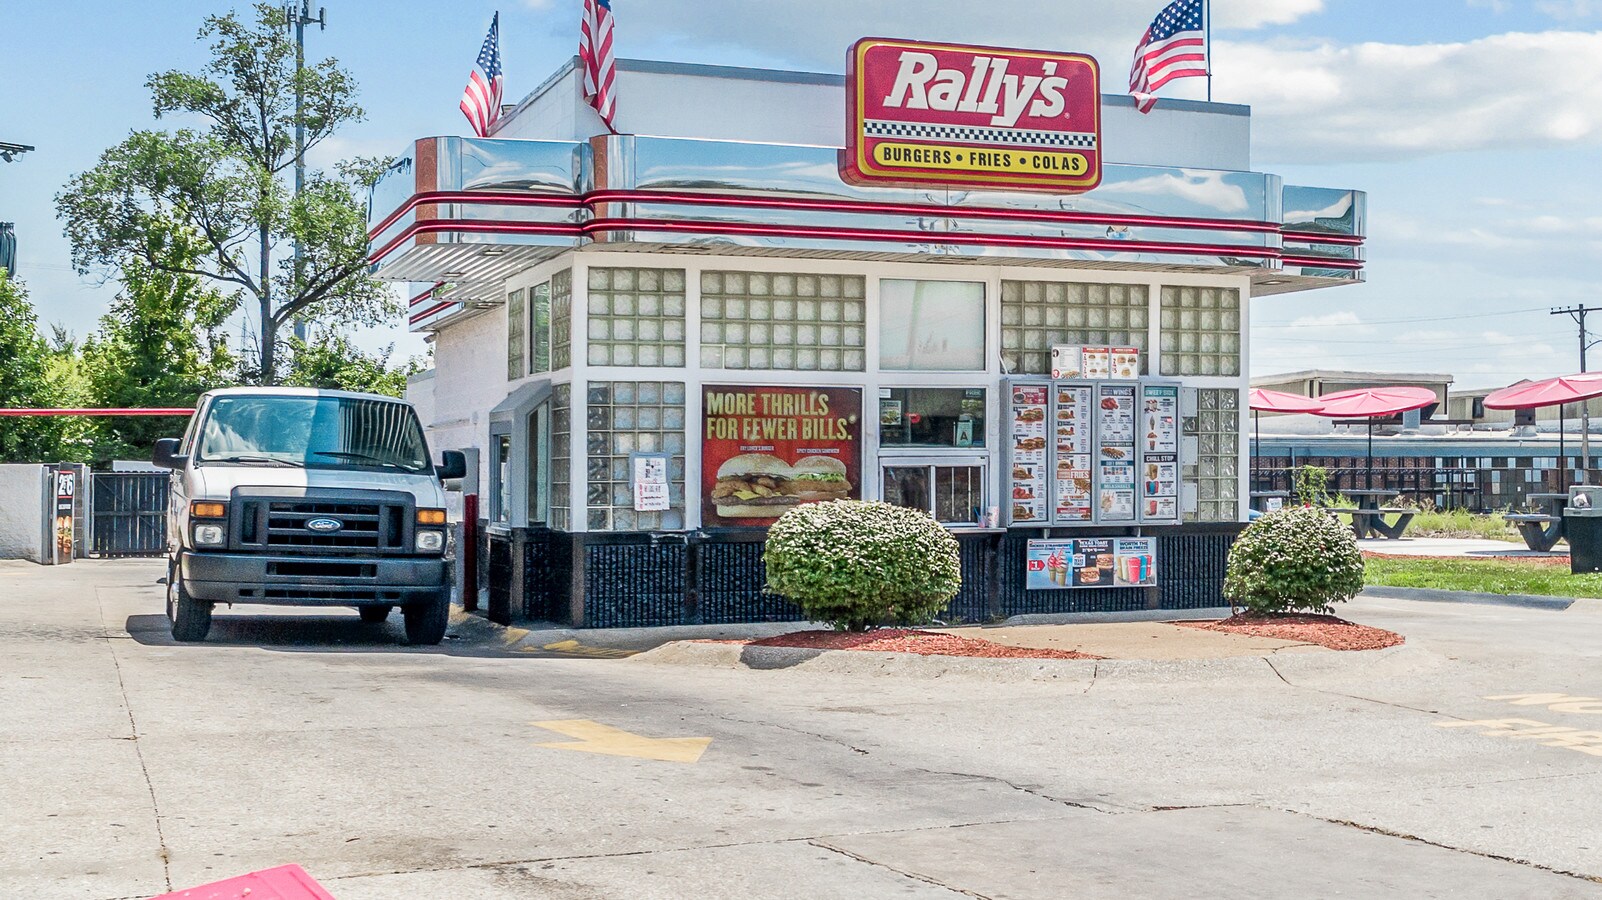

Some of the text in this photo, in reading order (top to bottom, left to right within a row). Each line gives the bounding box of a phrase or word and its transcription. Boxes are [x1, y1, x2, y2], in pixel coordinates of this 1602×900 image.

[882, 51, 1069, 127] Rally's
[883, 146, 1080, 170] BURGERS FRIES COLAS
[706, 392, 829, 416] MORE THRILLS
[706, 417, 853, 440] FOR FEWER BILLS.
[960, 431, 969, 441] A
[1071, 470, 1090, 479] FRIES
